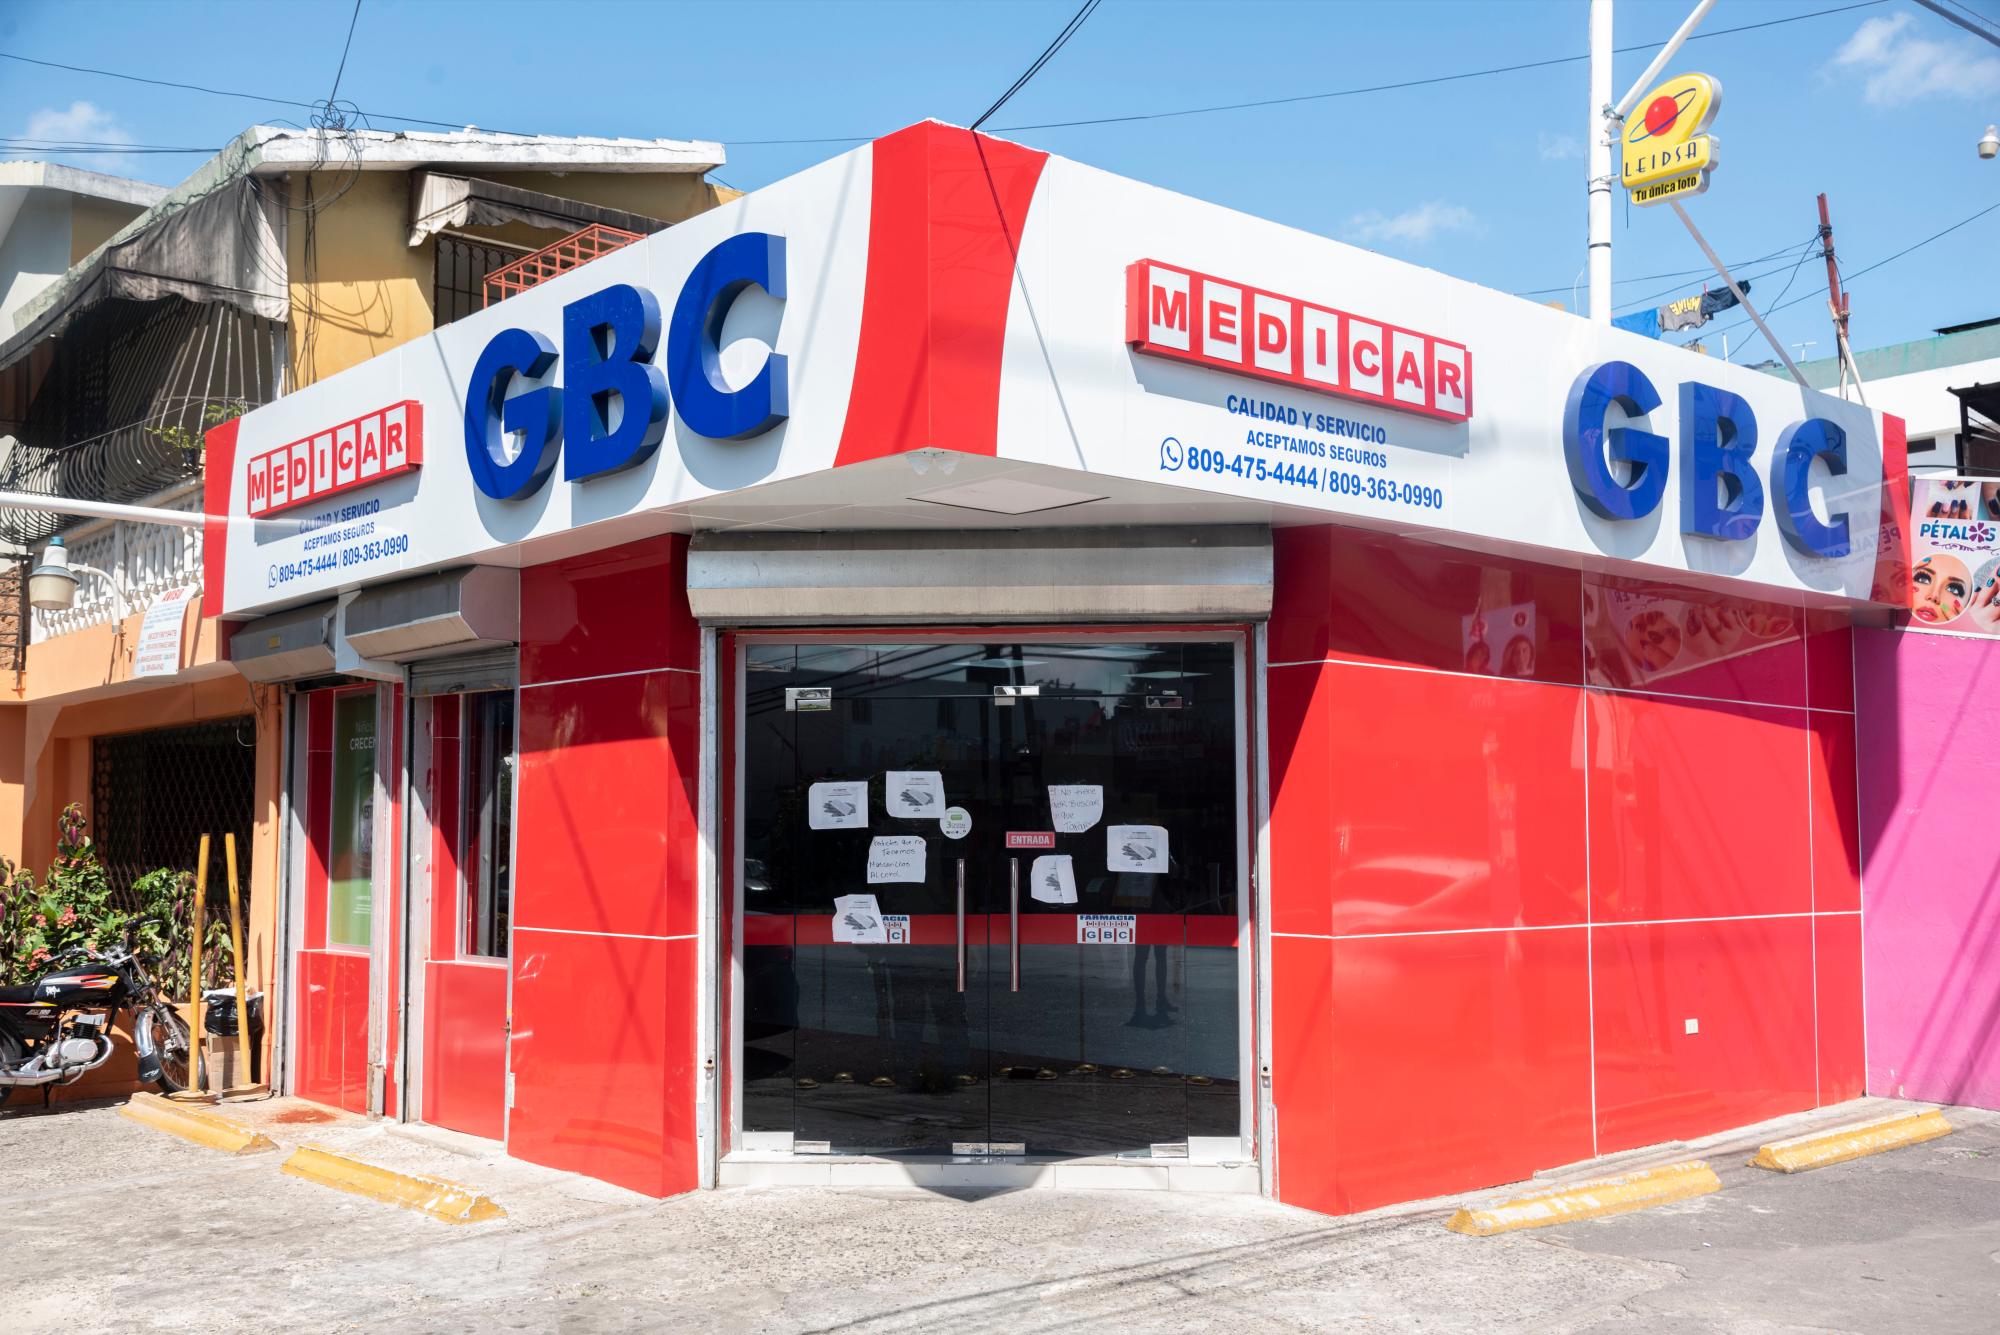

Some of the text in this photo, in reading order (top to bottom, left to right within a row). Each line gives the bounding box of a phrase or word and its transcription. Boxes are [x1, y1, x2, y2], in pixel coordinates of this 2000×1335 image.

[1625, 142, 1697, 177] LEIDSA
[1635, 189, 1647, 202] Tu
[1649, 181, 1676, 198] única
[1151, 284, 1463, 400] MEDICAR
[465, 232, 788, 500] GBC
[1227, 394, 1387, 445] CALIDAD Y SERVICIO
[251, 421, 404, 502] MEDICAR
[1246, 430, 1388, 469] ACEPTAMOS SEGUROS
[1563, 360, 1851, 558] GBC
[299, 498, 380, 535] CALIDAD Y SERVICIO
[303, 521, 376, 552] ACEPTAMOS SEGUROS
[1011, 835, 1050, 845] ENTRADA
[1086, 931, 1129, 939] GBC
